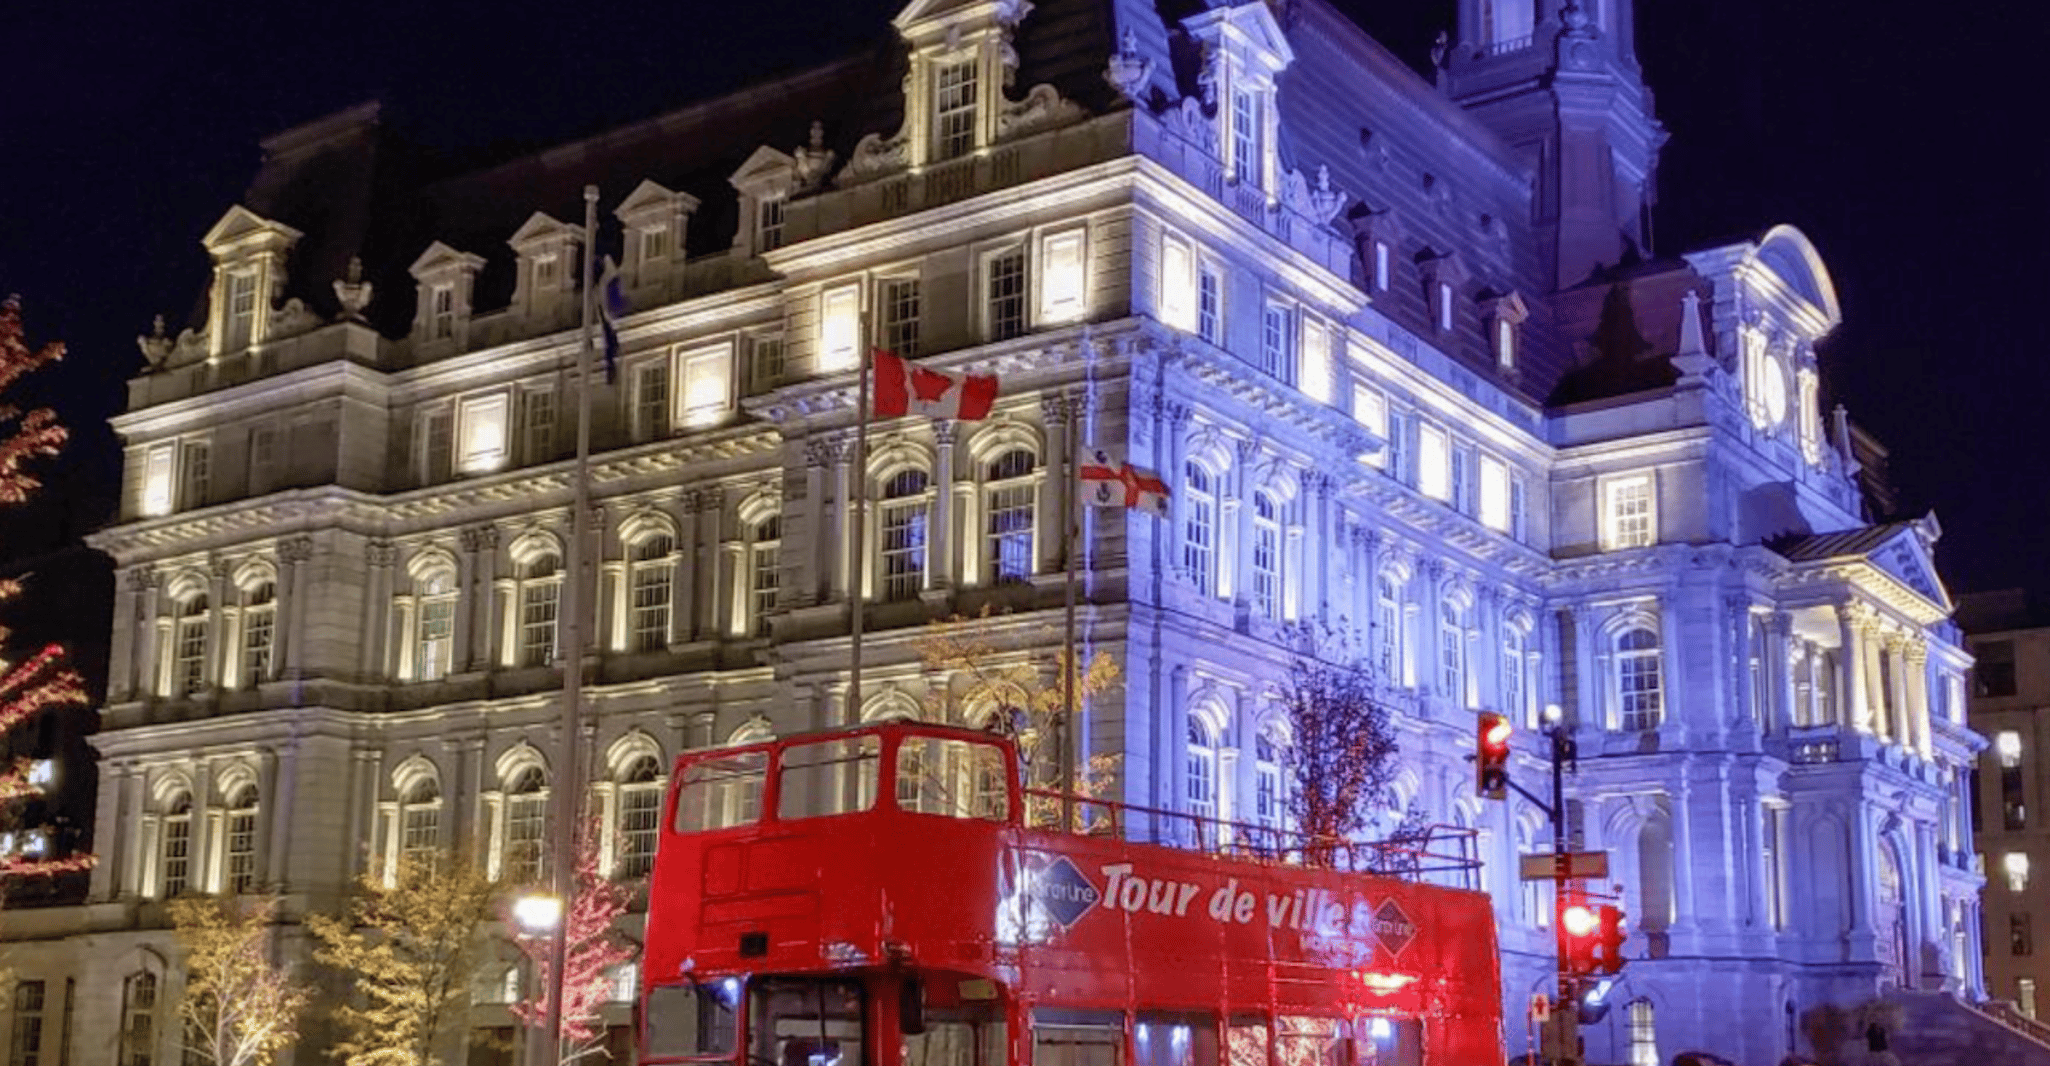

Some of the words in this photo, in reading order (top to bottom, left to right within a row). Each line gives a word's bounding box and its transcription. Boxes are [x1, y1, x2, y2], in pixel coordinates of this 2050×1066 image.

[1100, 863, 1200, 916] Tour
[1208, 877, 1255, 923] de
[1267, 888, 1345, 932] ville
